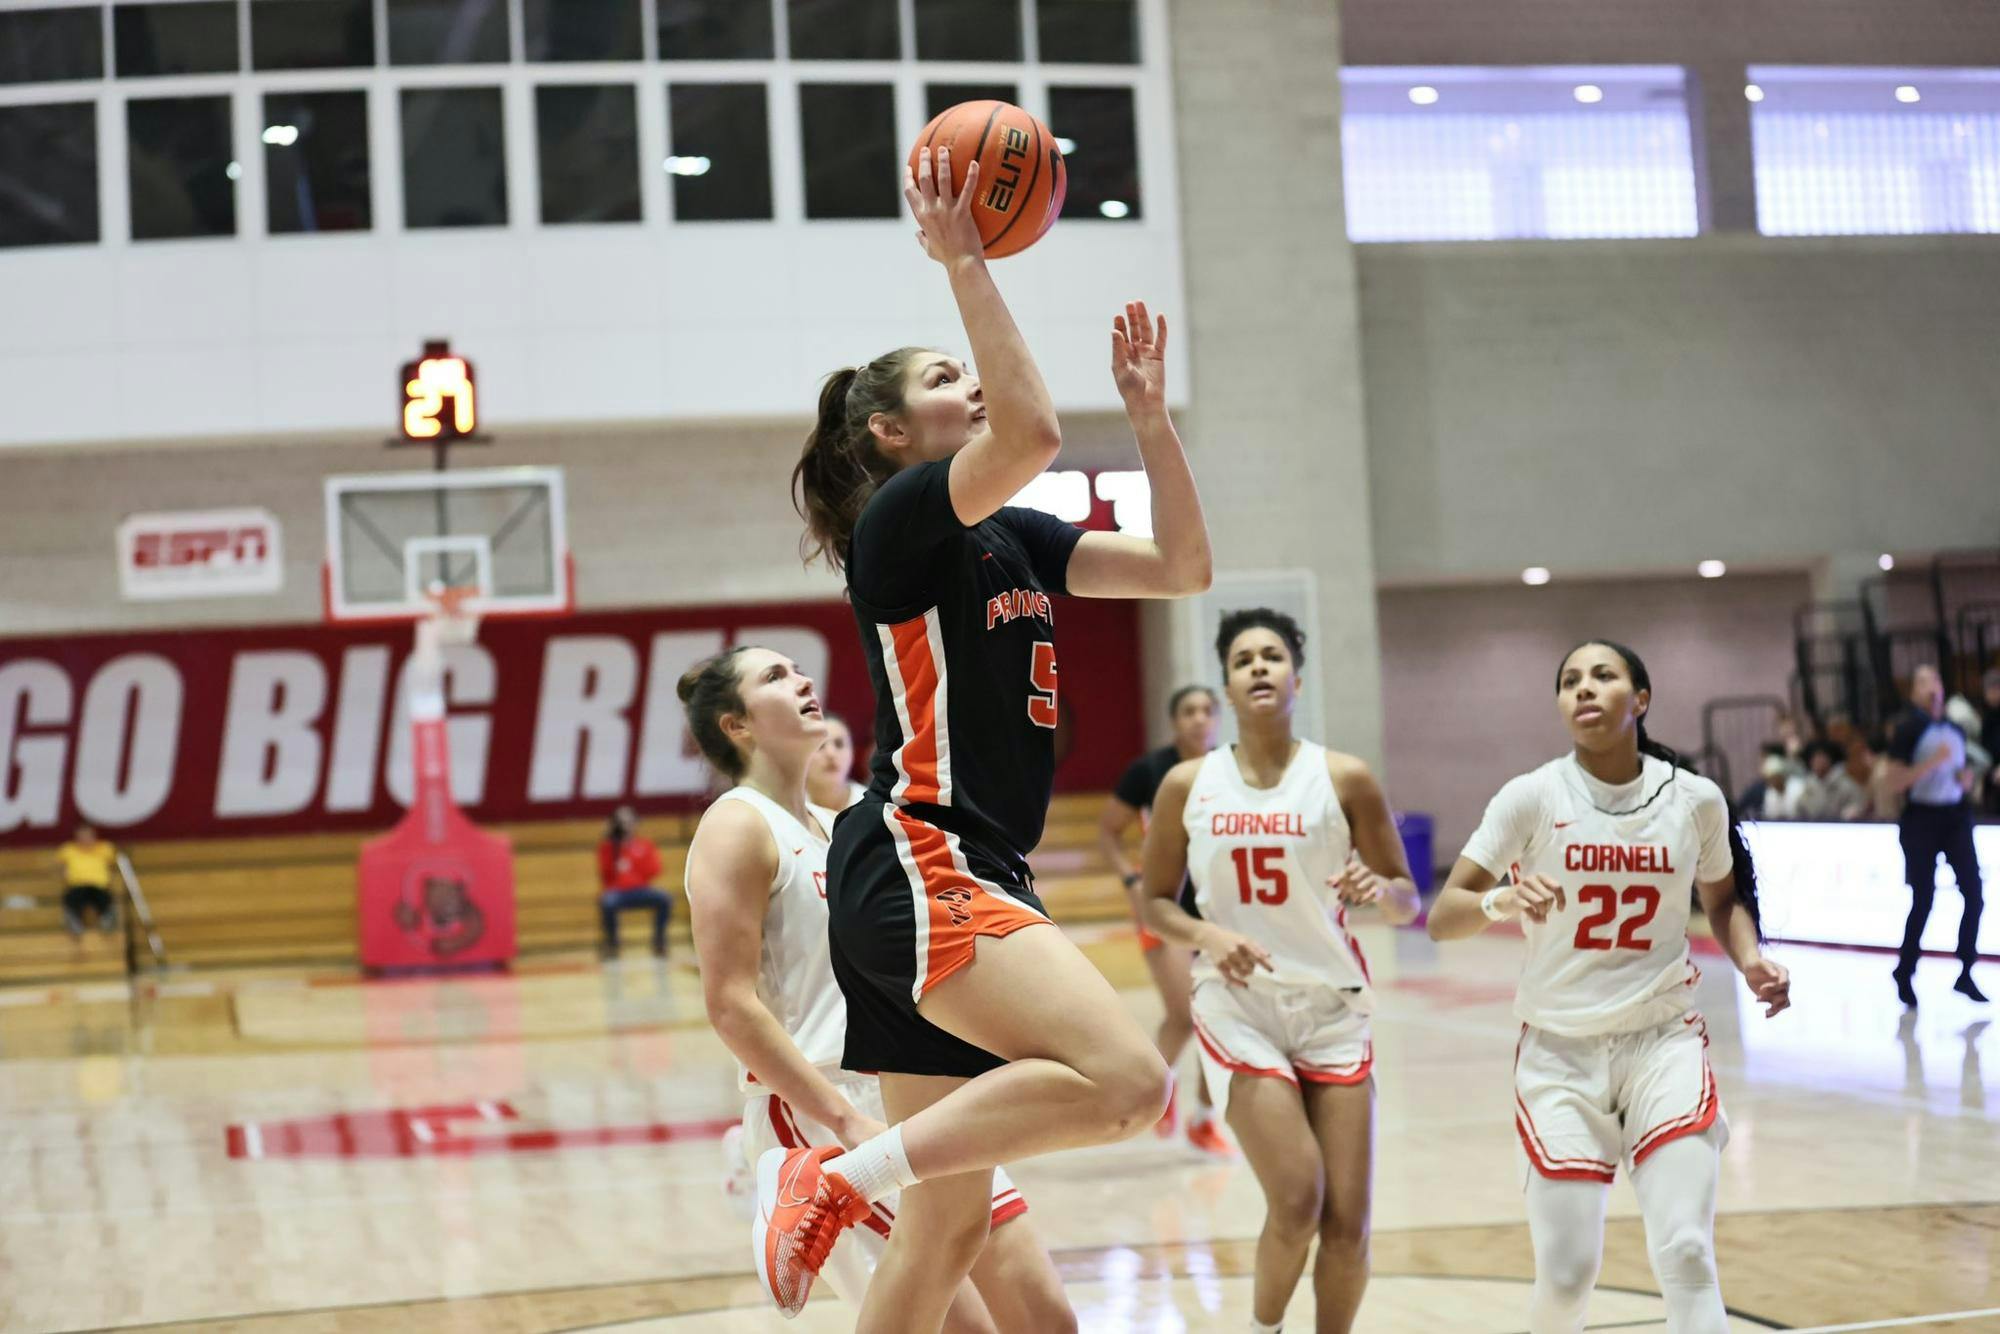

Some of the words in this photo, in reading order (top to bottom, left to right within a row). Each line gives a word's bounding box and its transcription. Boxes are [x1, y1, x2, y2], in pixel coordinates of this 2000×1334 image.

[986, 127, 1030, 213] ELITE
[404, 358, 474, 437] 27
[1027, 641, 1057, 729] 5
[0, 652, 184, 832] GO
[1211, 813, 1306, 837] CORNELL
[1565, 844, 1675, 874] CORNELL
[1231, 846, 1289, 906] 15
[1573, 884, 1661, 951] 22
